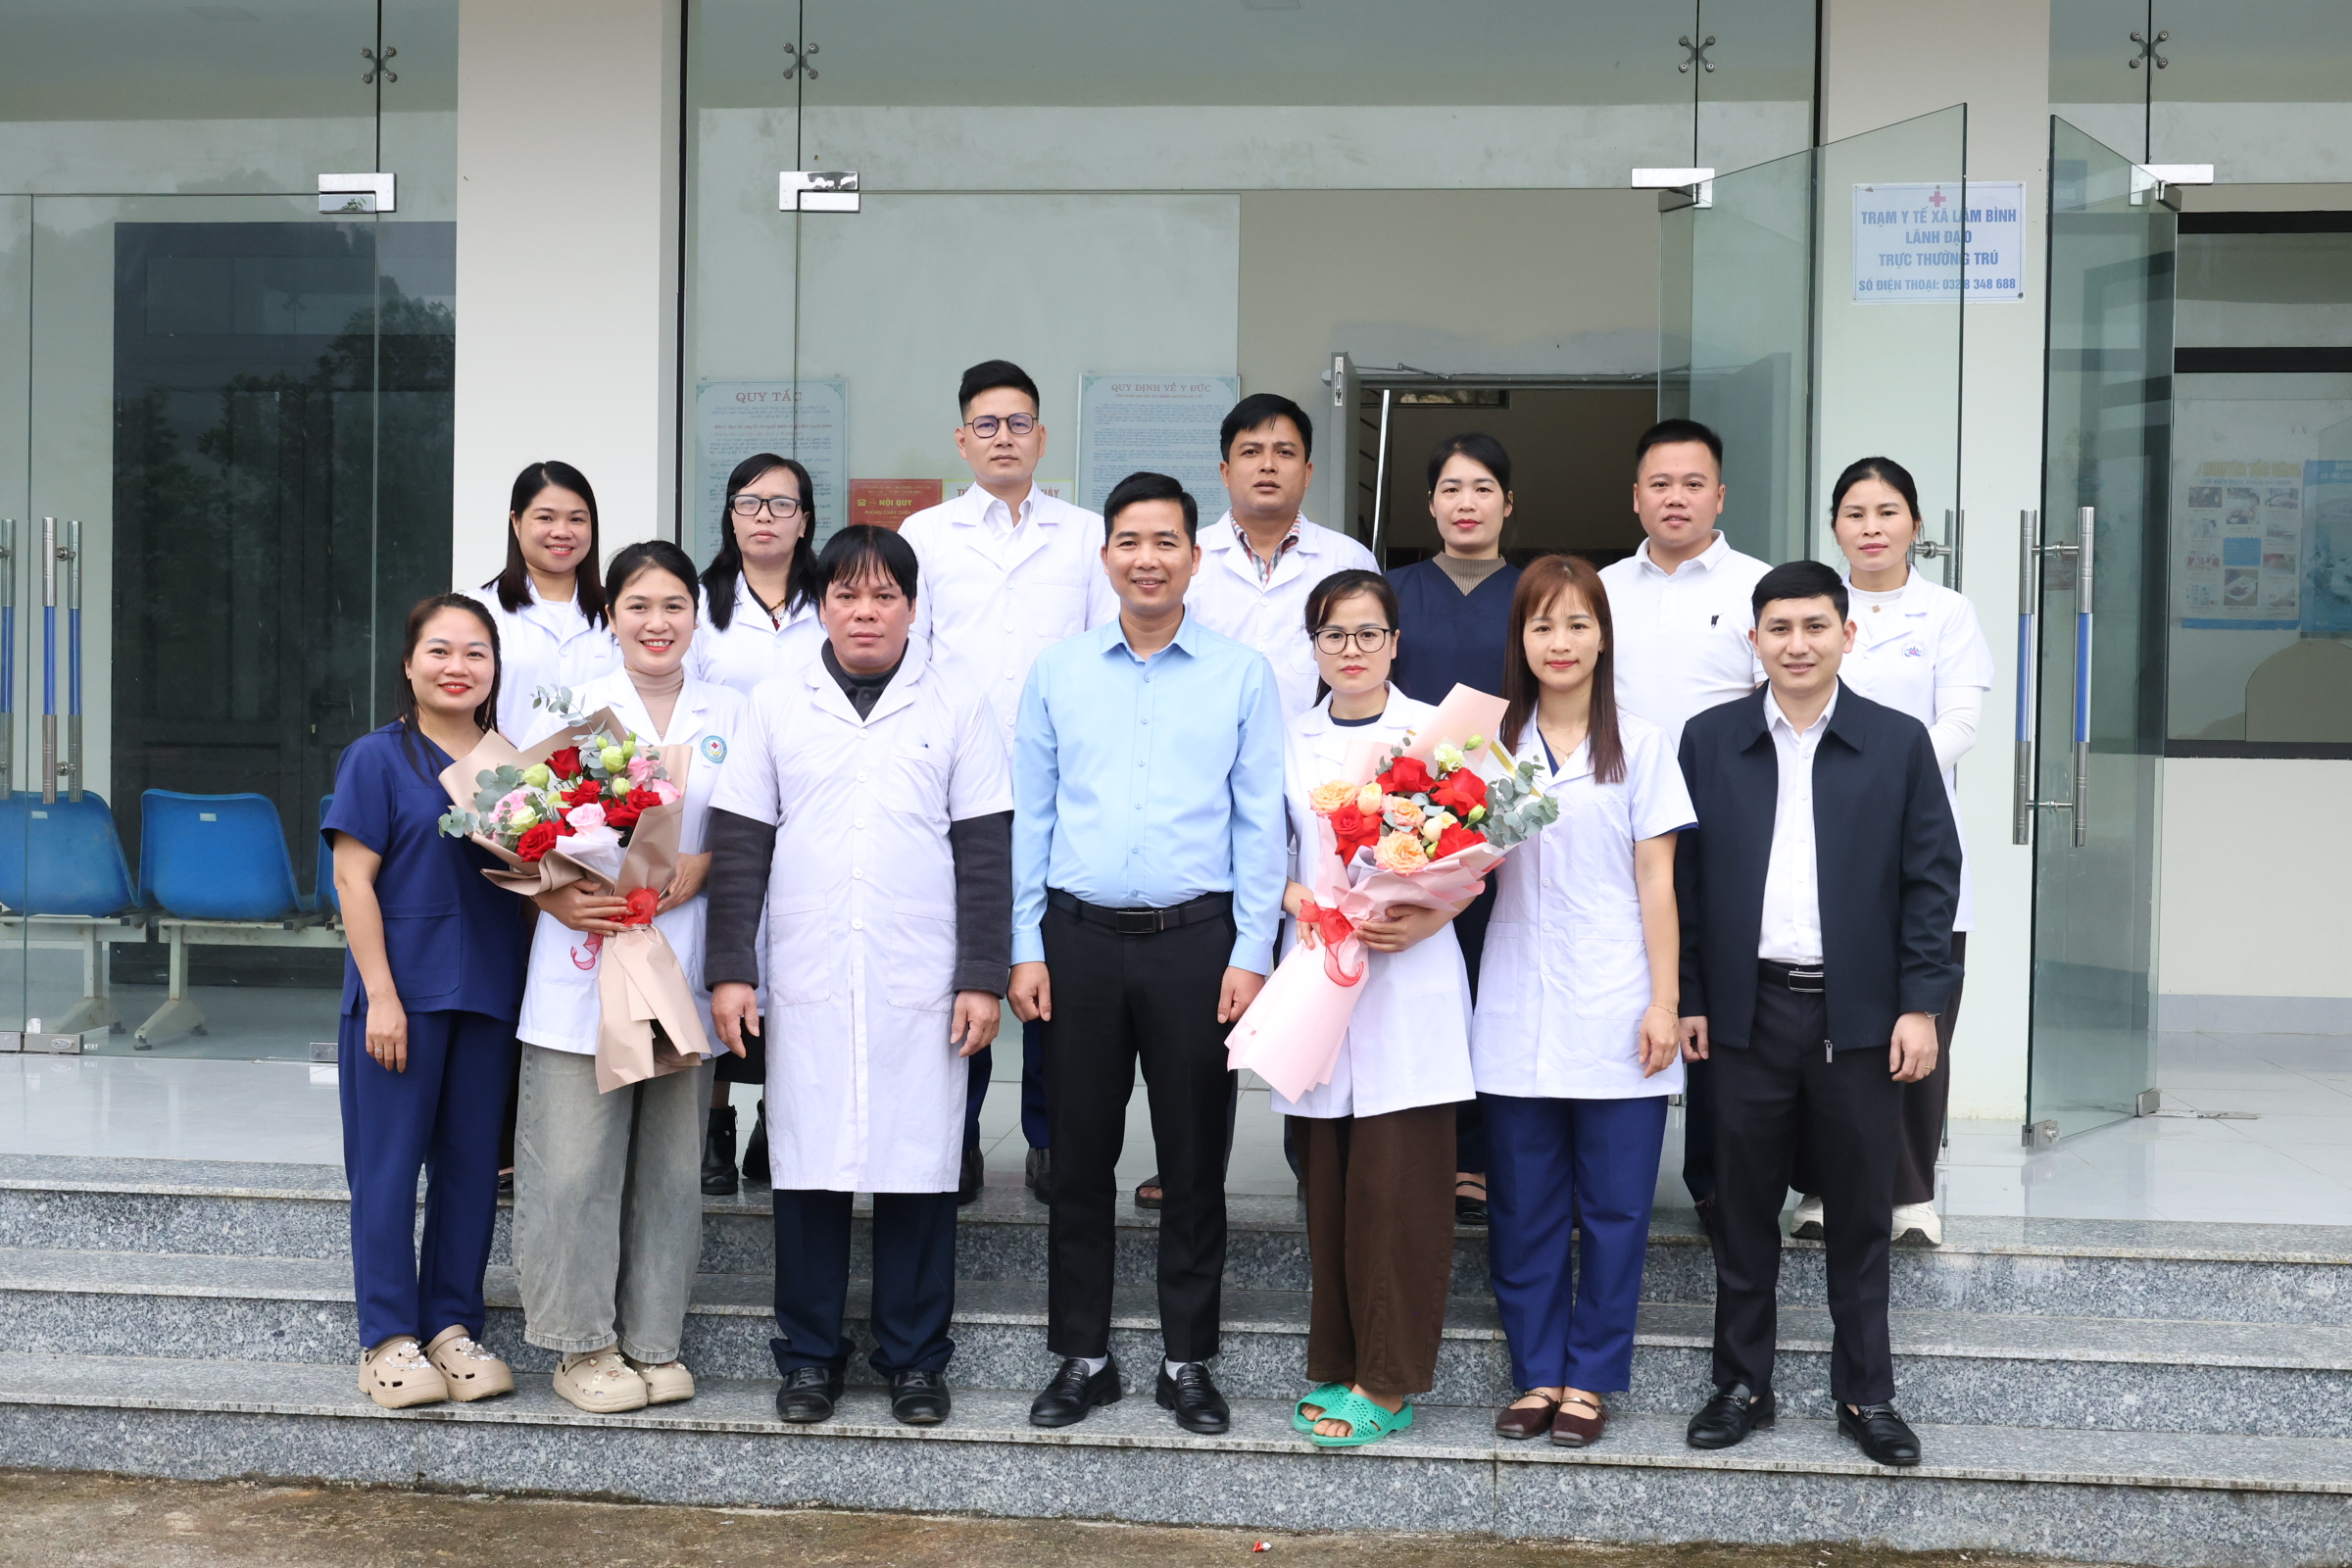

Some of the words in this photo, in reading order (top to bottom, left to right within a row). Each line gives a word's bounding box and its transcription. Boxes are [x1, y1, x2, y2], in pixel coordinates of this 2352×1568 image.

[1861, 211, 1897, 227] TRẠM
[1901, 211, 1909, 224] Y
[1912, 206, 1928, 224] TẾ
[1932, 208, 1948, 223] XÃ
[1985, 206, 2017, 222] BÌNH
[1905, 228, 1940, 244] LÃNH
[1943, 230, 1972, 246] ĐẠO
[1879, 251, 1912, 269] TRỰC
[1916, 250, 1970, 267] THƯỜNG
[1974, 249, 1999, 266] TRÚ
[1858, 276, 1874, 291] SỐ
[1876, 277, 1902, 293] ĐIỆN
[1904, 279, 1939, 293] THOẠI:
[1942, 278, 1971, 290] 0328
[1973, 278, 1993, 290] 348
[1996, 278, 2016, 289] 688
[736, 391, 767, 404] QUY
[772, 388, 803, 402] TẮC
[1110, 383, 1132, 393] QUY
[1135, 383, 1160, 394] ĐỊNH
[1163, 381, 1177, 392] VỀ
[1190, 383, 1211, 393] ĐỨC
[879, 498, 894, 508] NỘI
